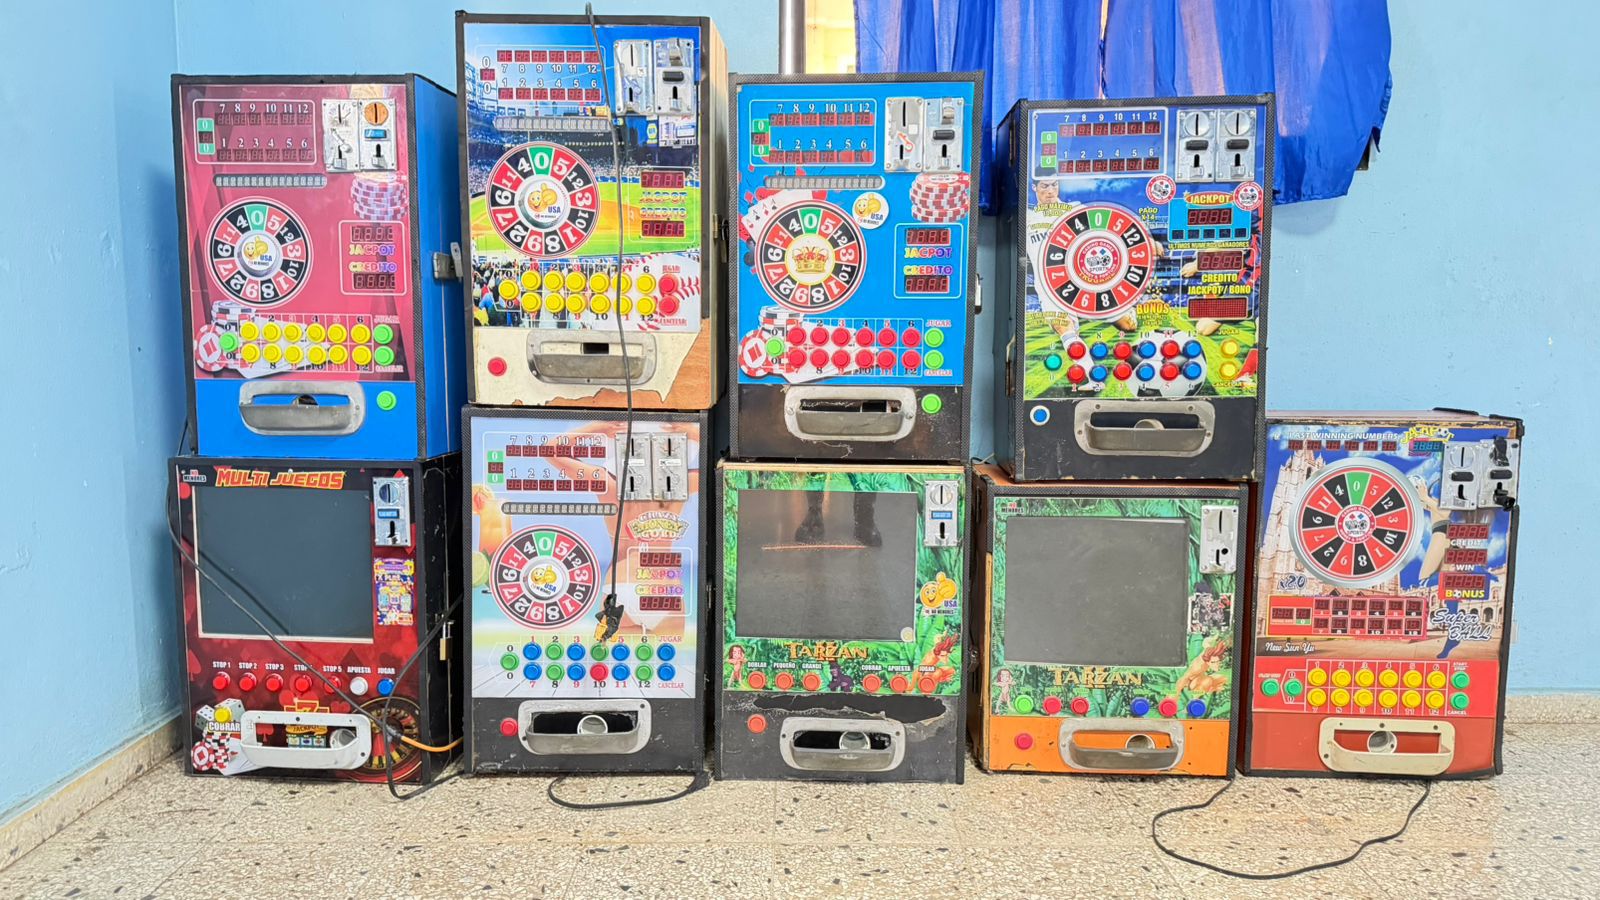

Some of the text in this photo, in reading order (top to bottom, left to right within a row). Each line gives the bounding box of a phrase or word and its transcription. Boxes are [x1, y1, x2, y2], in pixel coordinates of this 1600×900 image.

[517, 157, 532, 173] 4
[534, 152, 549, 169] 0
[553, 157, 570, 175] 5
[501, 171, 518, 188] 11
[567, 171, 584, 190] 12
[495, 190, 512, 205] 6
[575, 192, 592, 207] 3
[1190, 196, 1231, 204] JACKPOT
[495, 212, 513, 227] 7
[575, 210, 589, 229] 10
[1074, 218, 1085, 231] 4
[1095, 212, 1102, 226] 0
[1113, 218, 1124, 232] 5
[509, 224, 527, 243] 2
[563, 226, 578, 244] 1
[1055, 229, 1073, 246] 11
[1123, 228, 1140, 246] 12
[527, 234, 541, 252] 9
[545, 235, 560, 252] 8
[349, 244, 395, 256] JACPOT
[904, 247, 952, 258] JACPOT
[1131, 250, 1145, 259] 3
[1050, 253, 1064, 261] 6
[349, 262, 397, 273] CREDITO
[903, 265, 953, 276] CREDITO
[1051, 271, 1065, 279] 7
[1126, 266, 1143, 283] 10
[1202, 274, 1238, 283] CREDITO
[1062, 284, 1075, 297] 2
[1117, 286, 1129, 297] 1
[1230, 285, 1251, 294] BONO
[1081, 294, 1090, 307] 9
[1101, 293, 1110, 307] 8
[1137, 304, 1170, 314] BONOS
[215, 469, 345, 490] MULTI JUEGOS
[636, 568, 684, 580] JACPOT
[544, 582, 557, 593] USA
[635, 584, 684, 595] CREDITO
[1445, 590, 1485, 598] BONUS
[944, 600, 958, 608] USA
[784, 642, 869, 659] TARZAN
[1265, 642, 1315, 654] New Sun Yu
[773, 661, 796, 669] PEQUEÑO
[1050, 667, 1143, 686] TARZAN
[208, 722, 241, 732] COBRAR
